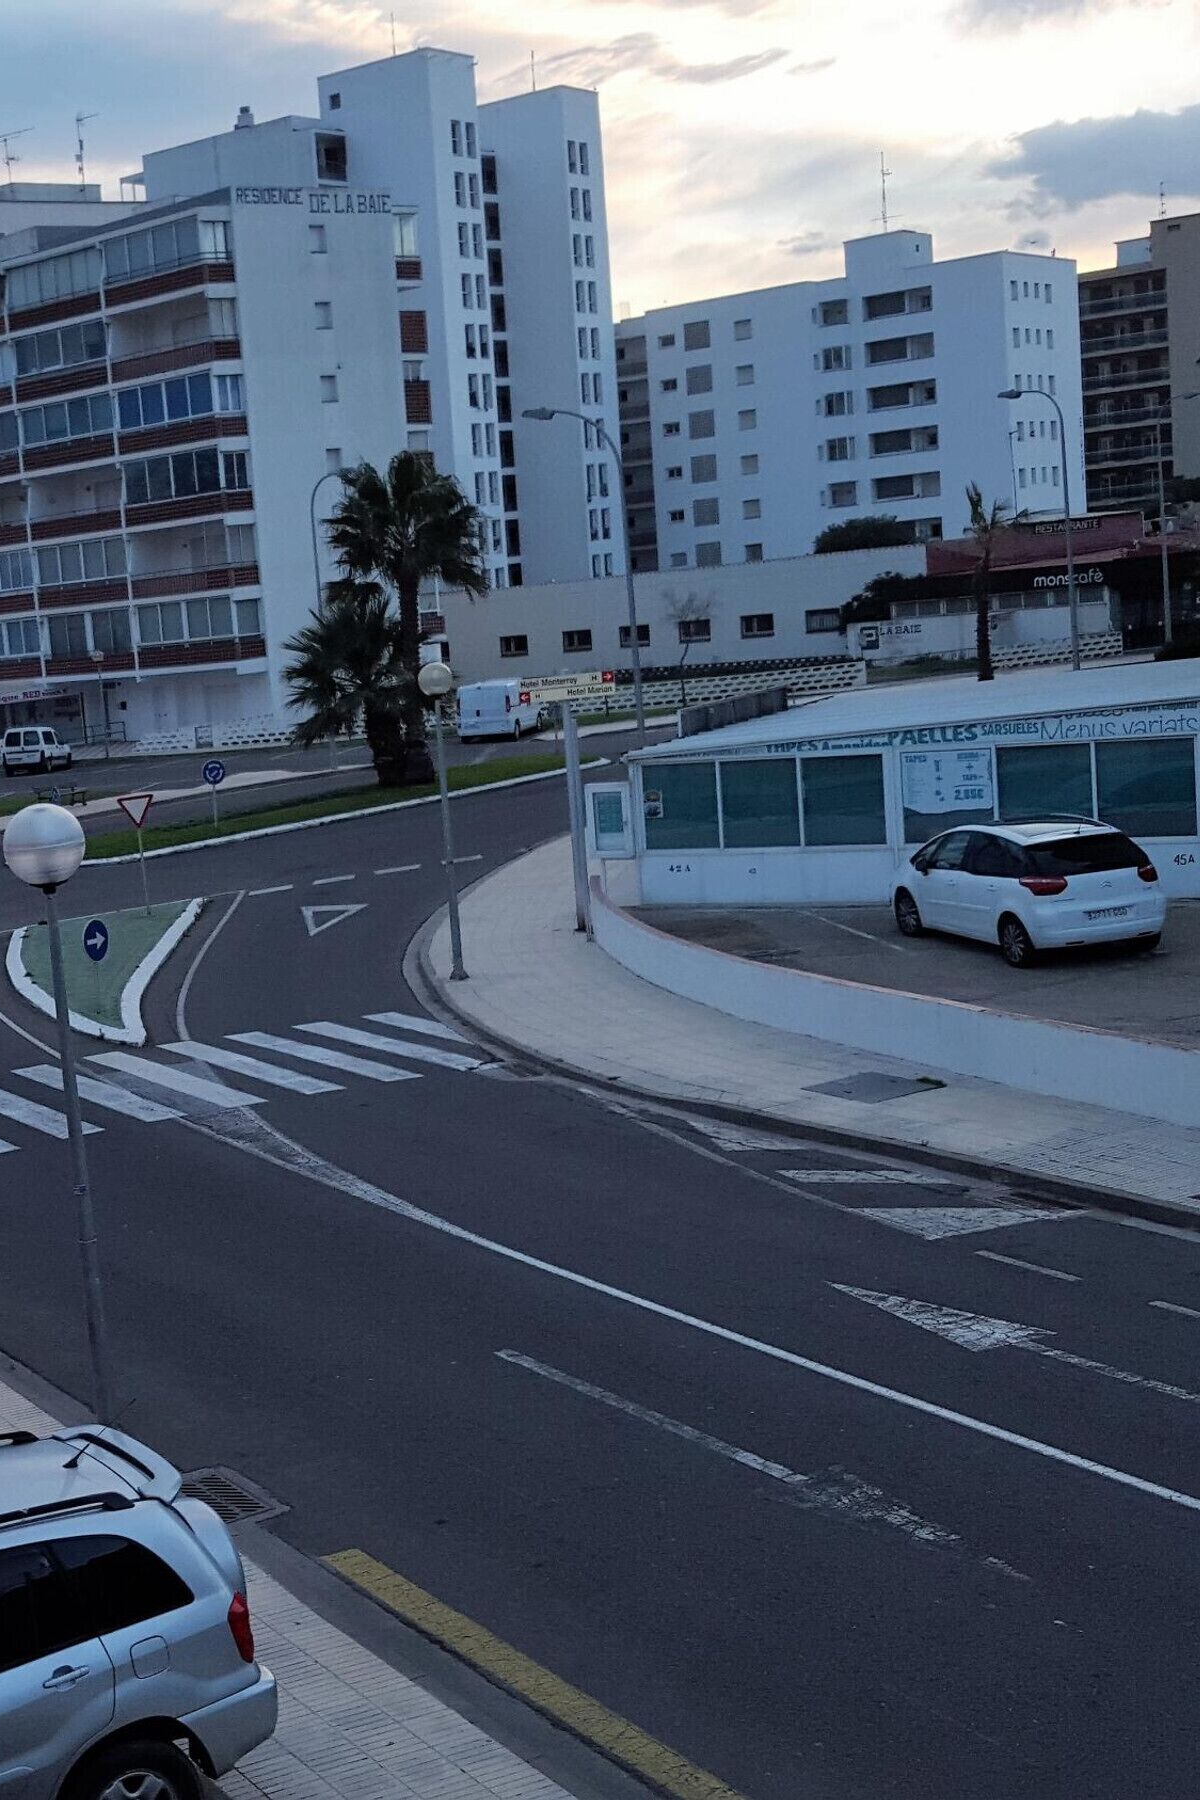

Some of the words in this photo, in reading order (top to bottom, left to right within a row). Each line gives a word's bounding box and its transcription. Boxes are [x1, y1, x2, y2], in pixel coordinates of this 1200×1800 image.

[235, 187, 303, 205] RESIDENCE
[309, 194, 331, 213] DE
[334, 194, 355, 213] LA
[357, 194, 392, 213] BAIE
[520, 680, 539, 689] Hotel
[567, 687, 586, 696] Hotel
[886, 723, 978, 746] PAELLES
[980, 721, 1039, 736] SARSUELES
[1122, 713, 1199, 735] variats
